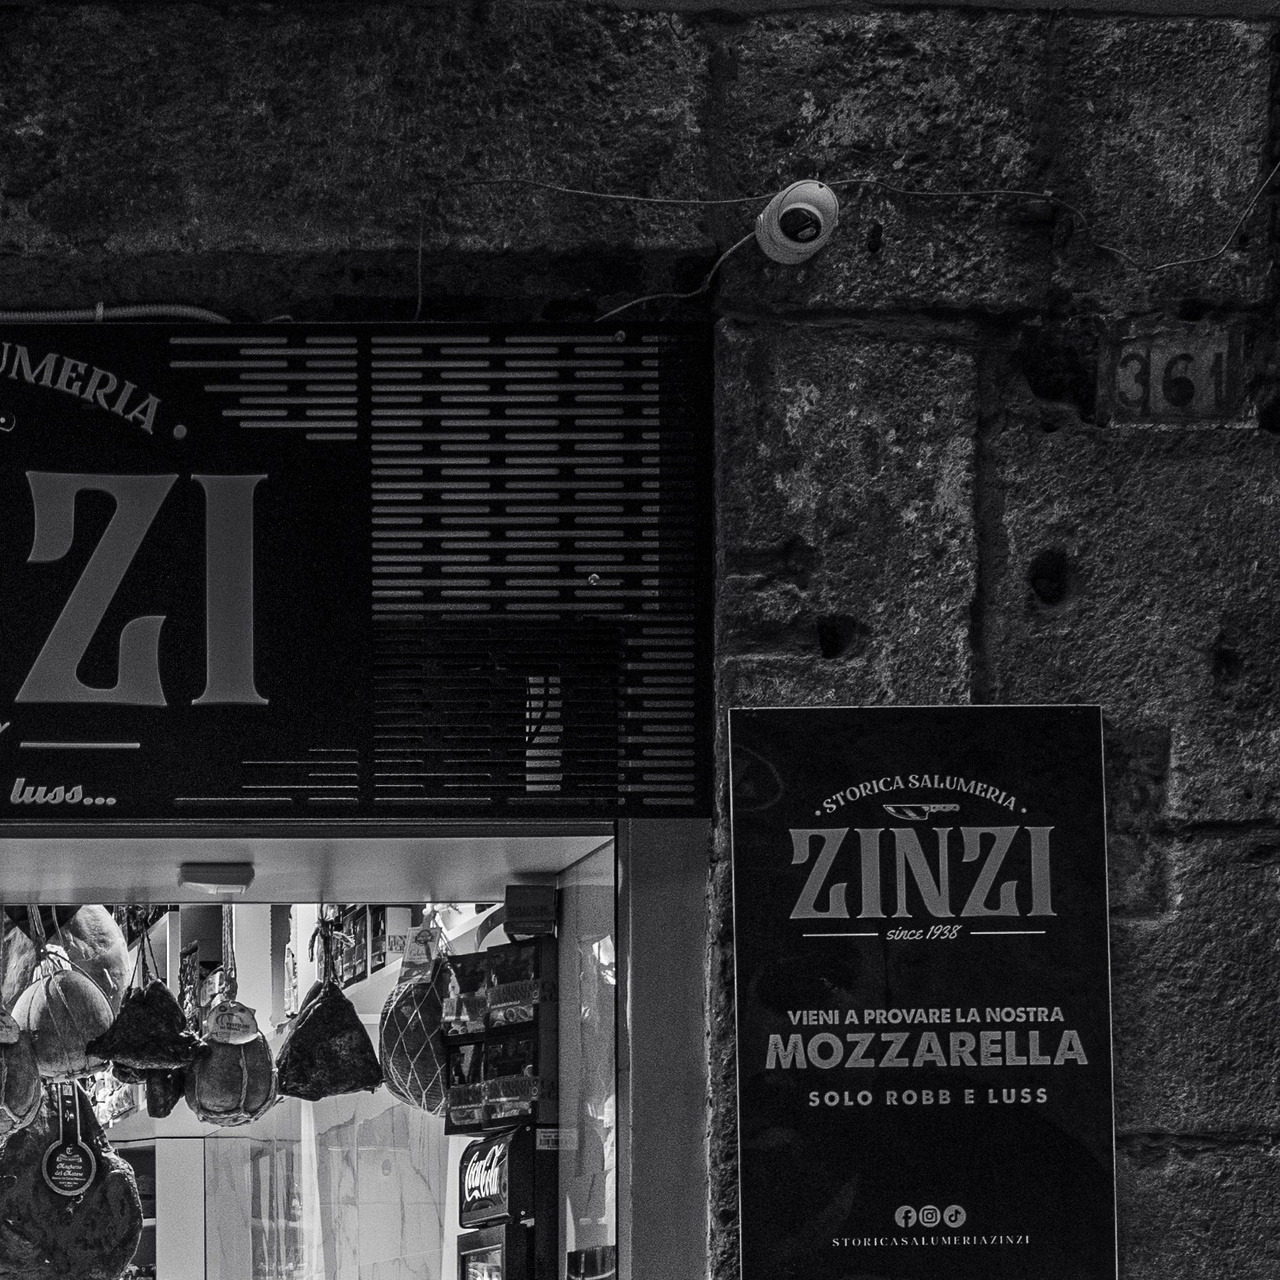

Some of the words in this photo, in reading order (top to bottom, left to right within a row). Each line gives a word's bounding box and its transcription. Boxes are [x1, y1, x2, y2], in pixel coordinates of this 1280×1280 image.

[823, 774, 906, 814] STORICA
[908, 773, 1017, 812] SALUMERIA
[788, 825, 1058, 920] ZINZI
[886, 926, 924, 941] since
[926, 923, 962, 940] 1938
[787, 1009, 840, 1026] VIENI
[844, 1009, 860, 1025] A
[864, 1008, 951, 1025] PROVARE
[956, 1007, 982, 1024] LA
[986, 1006, 1065, 1024] NOSTRA
[765, 1030, 1089, 1069] MOZZARELLA
[808, 1091, 874, 1108] SOLO
[886, 1089, 952, 1106] ROBB
[964, 1088, 975, 1105] E
[988, 1087, 1049, 1105] LUSS
[832, 1234, 1031, 1248] STORICASALUMERIAZINZI
